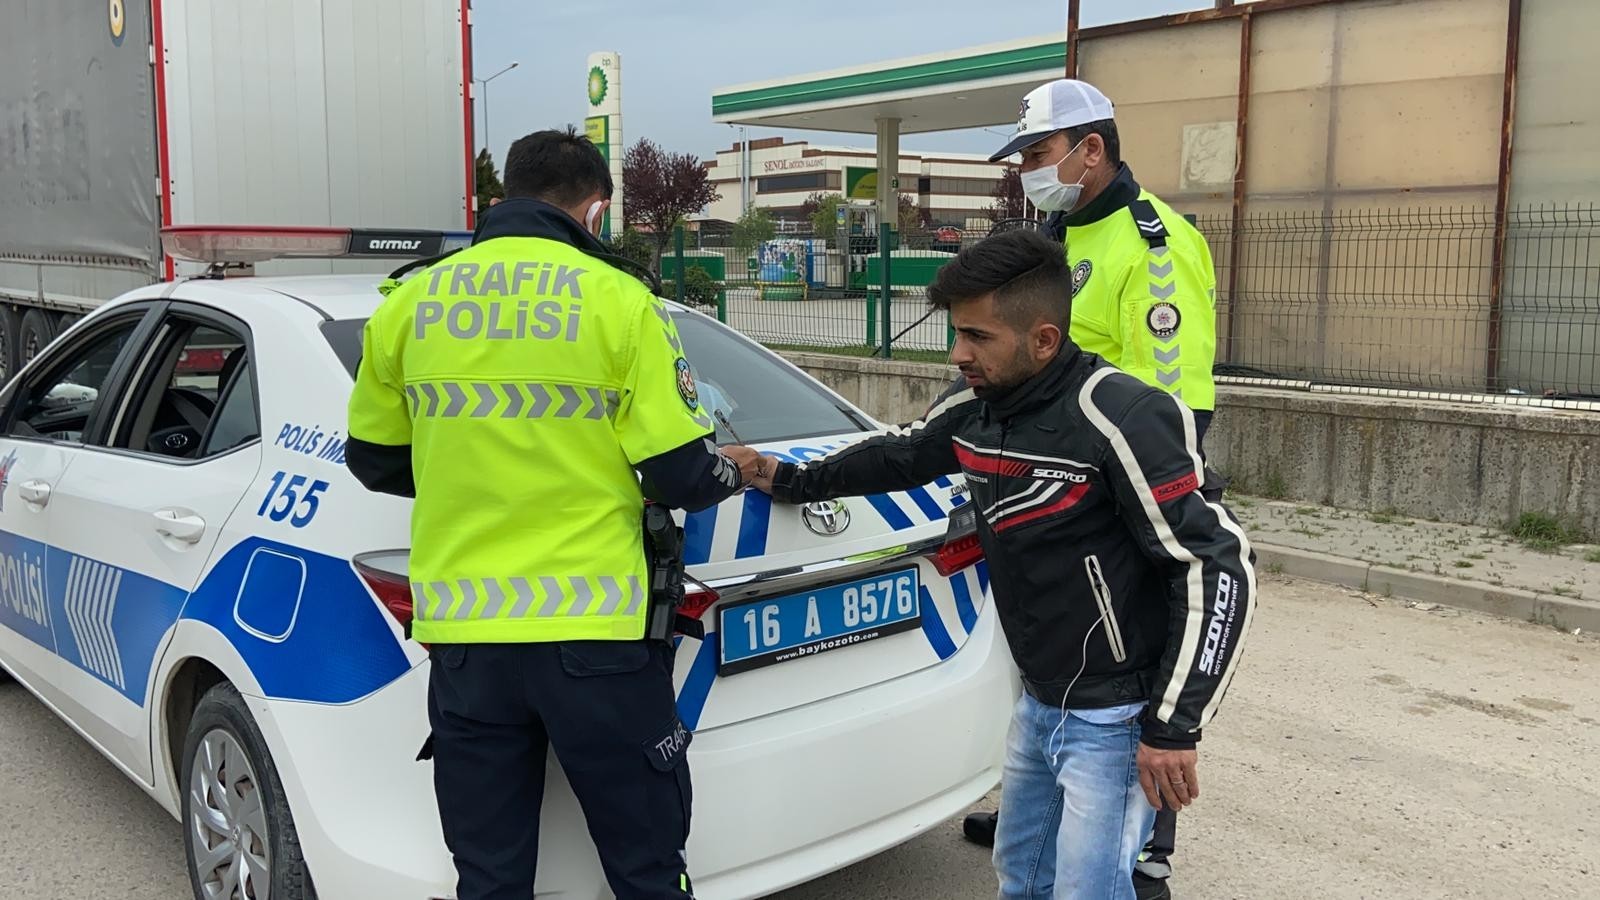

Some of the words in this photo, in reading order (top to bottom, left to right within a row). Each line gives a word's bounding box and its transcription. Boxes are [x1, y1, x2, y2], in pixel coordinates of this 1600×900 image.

[369, 239, 421, 249] armas
[1032, 468, 1087, 483] SCOYCO
[1158, 476, 1195, 496] SCOYCO
[257, 470, 330, 528] 155
[744, 604, 781, 650] 16
[804, 596, 822, 638] A
[842, 576, 912, 628] 8576
[1199, 571, 1231, 676] SCOYCO
[1214, 649, 1226, 675] MOTOR
[1223, 622, 1233, 648] SPORT
[1228, 579, 1239, 622] EQUIPMENT
[775, 631, 879, 662] www.baykozoto.com
